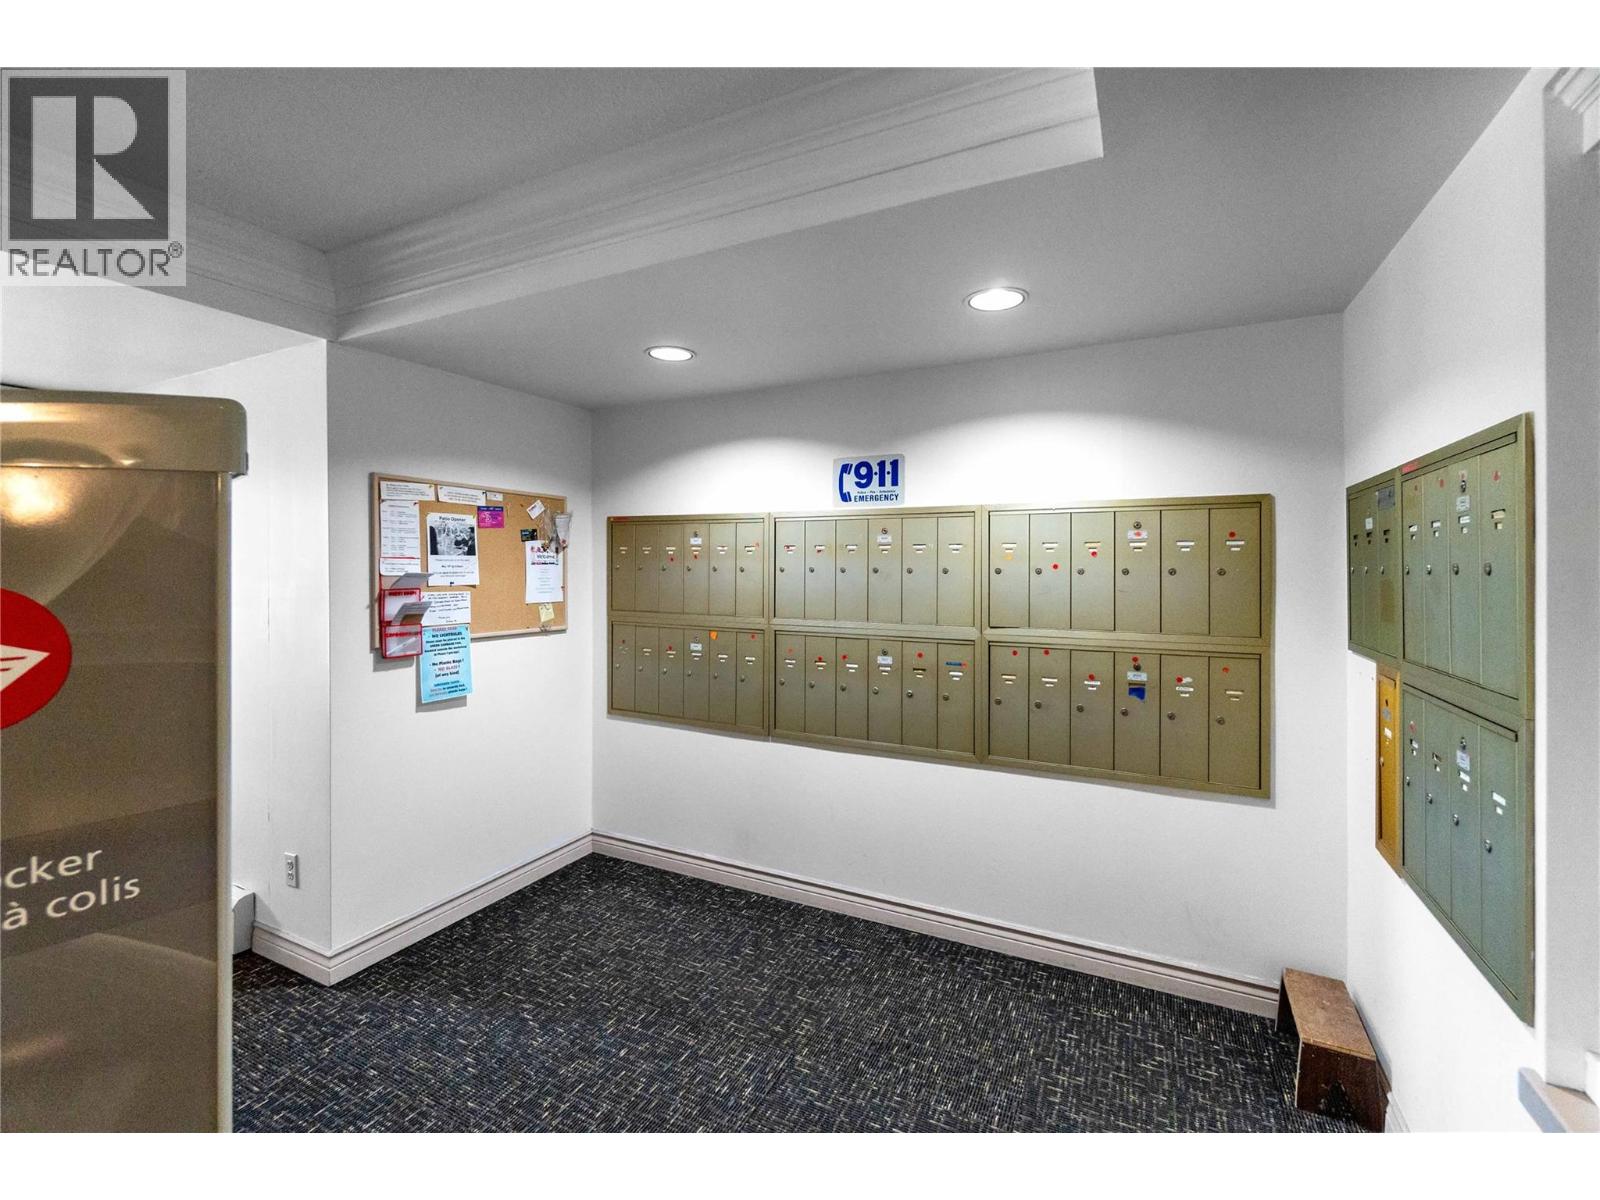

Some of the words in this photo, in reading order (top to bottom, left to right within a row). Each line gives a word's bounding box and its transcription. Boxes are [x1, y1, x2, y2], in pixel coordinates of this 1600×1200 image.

[854, 493, 899, 503] EMERGENCY
[0, 850, 103, 889] cker
[2, 901, 28, 930] à
[46, 876, 140, 918] colis
